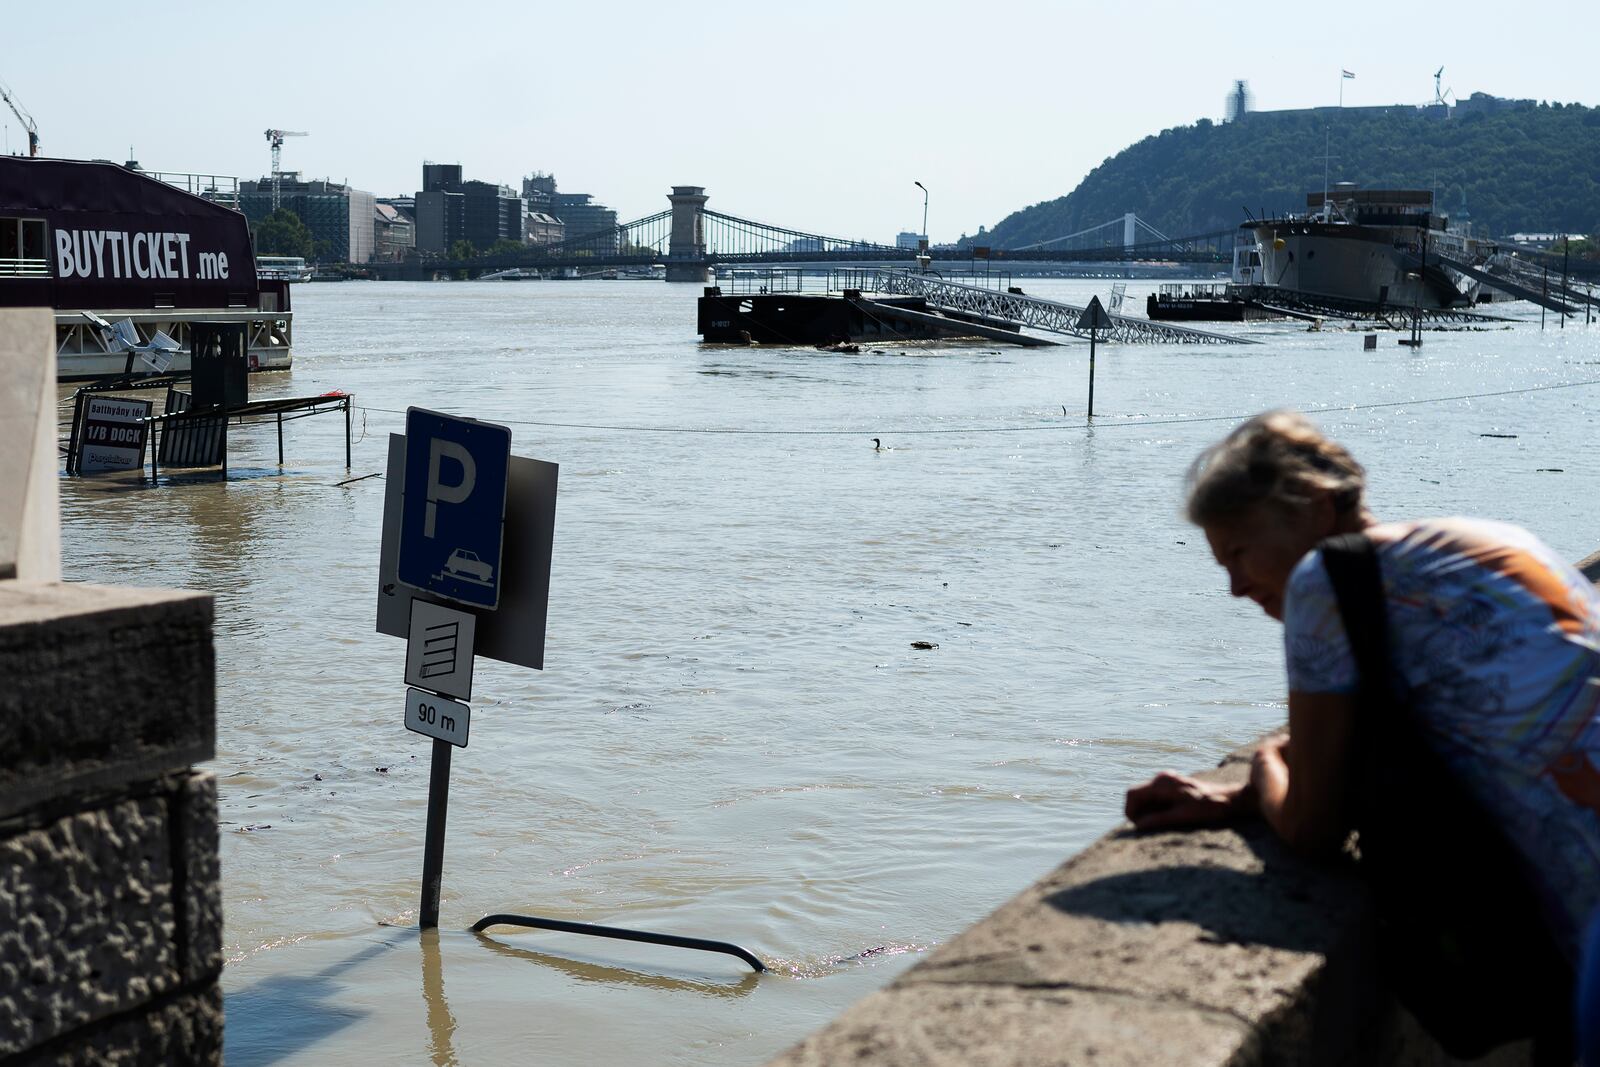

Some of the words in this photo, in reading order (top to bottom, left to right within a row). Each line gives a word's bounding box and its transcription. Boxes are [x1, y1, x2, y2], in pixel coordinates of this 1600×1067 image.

[91, 404, 131, 417] Batthyány
[132, 407, 144, 417] tér
[87, 425, 108, 440] 1/B
[110, 427, 142, 443] DOCK
[423, 437, 477, 538] P
[418, 702, 436, 725] 90
[440, 714, 456, 733] m
